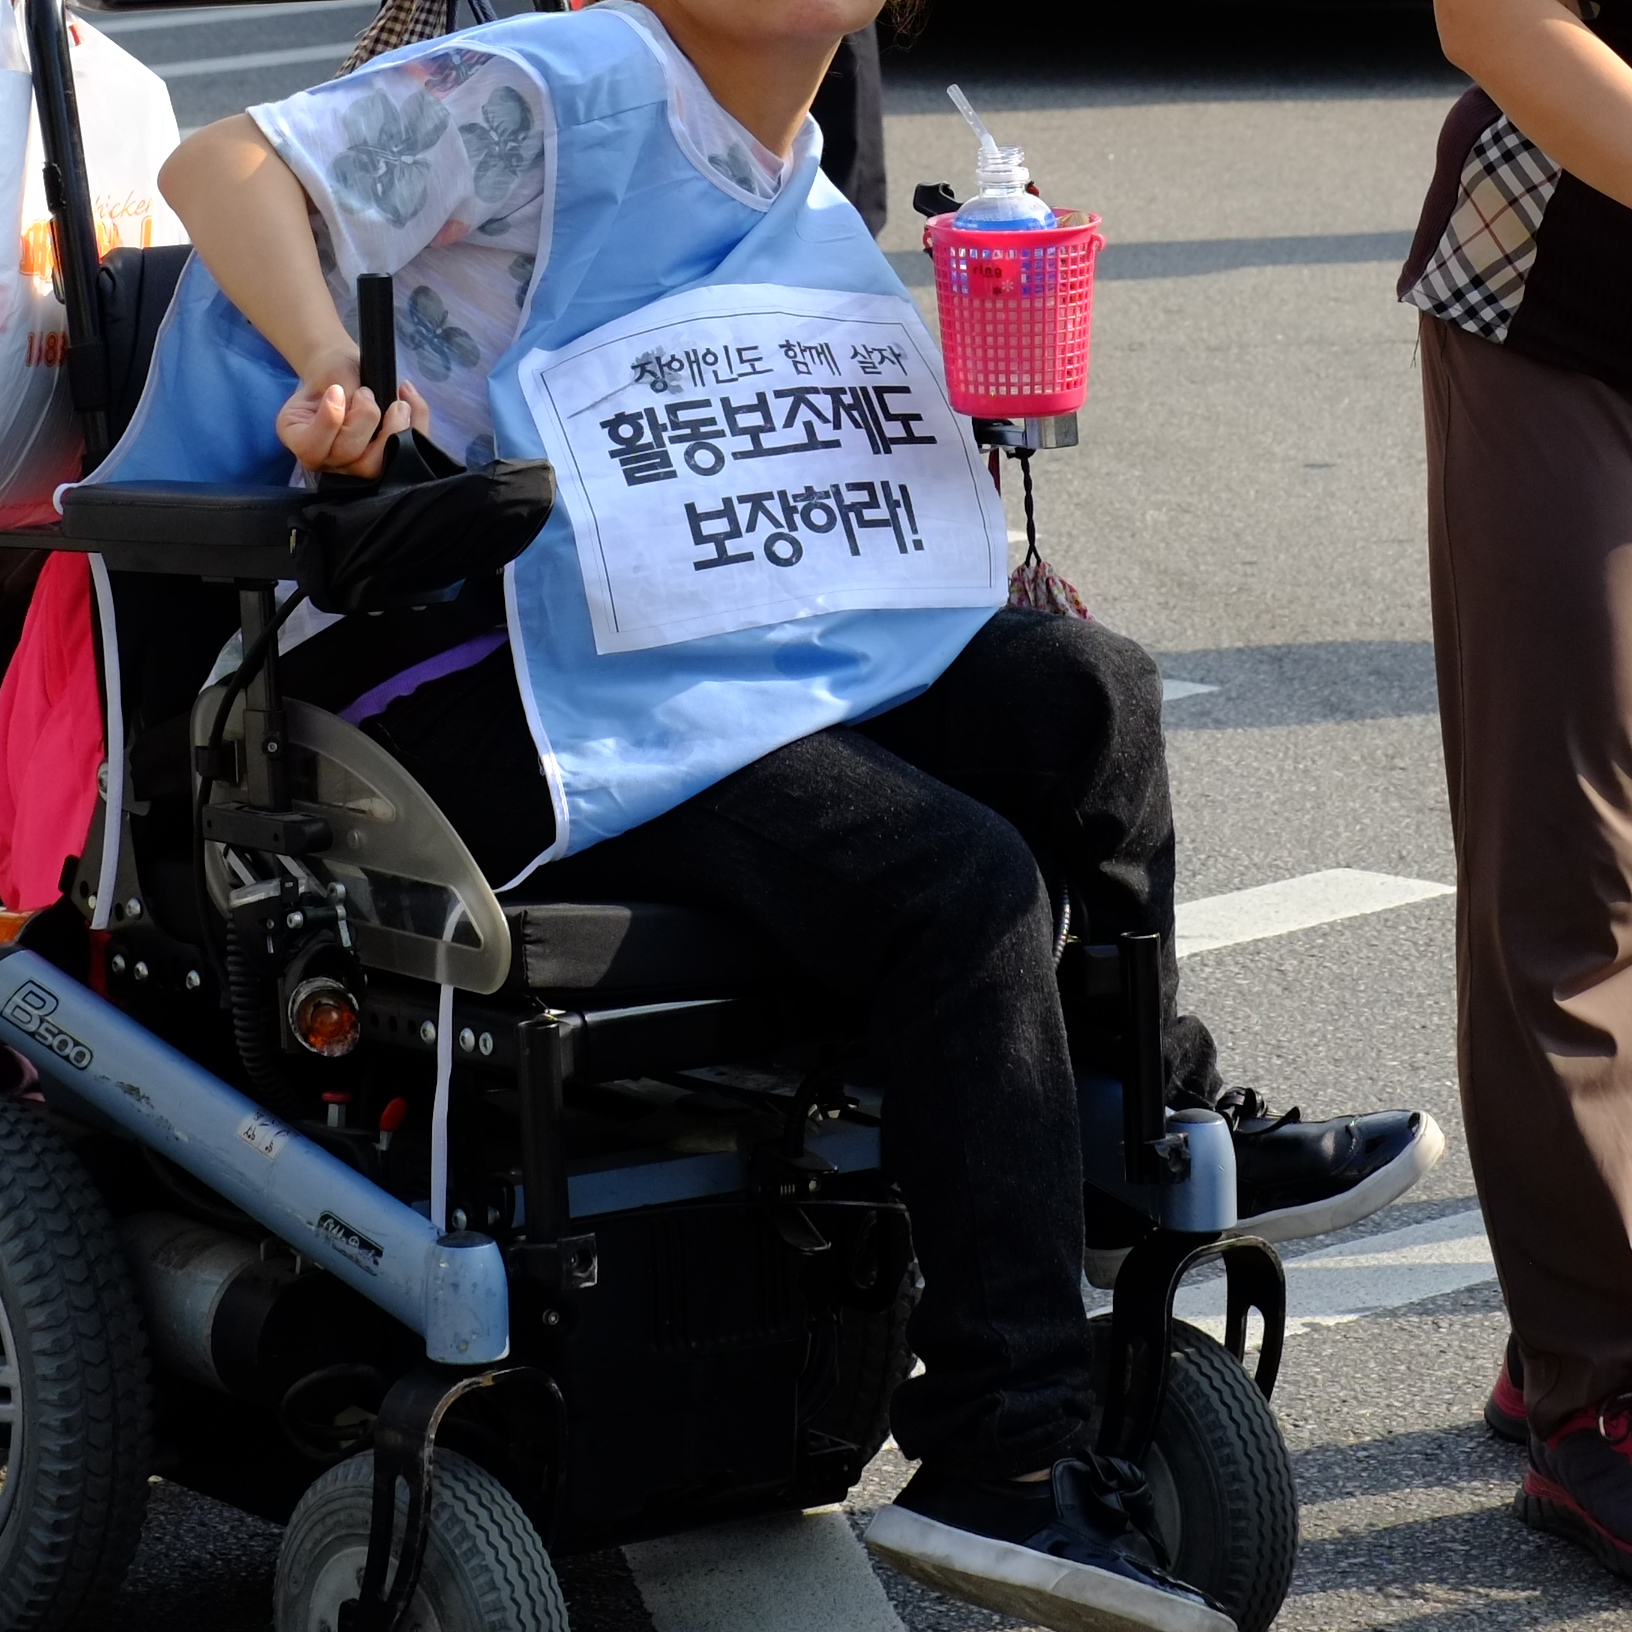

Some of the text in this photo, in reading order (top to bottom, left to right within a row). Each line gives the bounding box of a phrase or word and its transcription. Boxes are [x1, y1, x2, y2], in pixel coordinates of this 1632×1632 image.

[973, 264, 1003, 278] ring
[630, 339, 909, 394] 장애인도 함께 살자
[599, 385, 938, 487] 활동보조제도
[684, 480, 925, 572] 보장하라!
[0, 978, 93, 1071] B500
